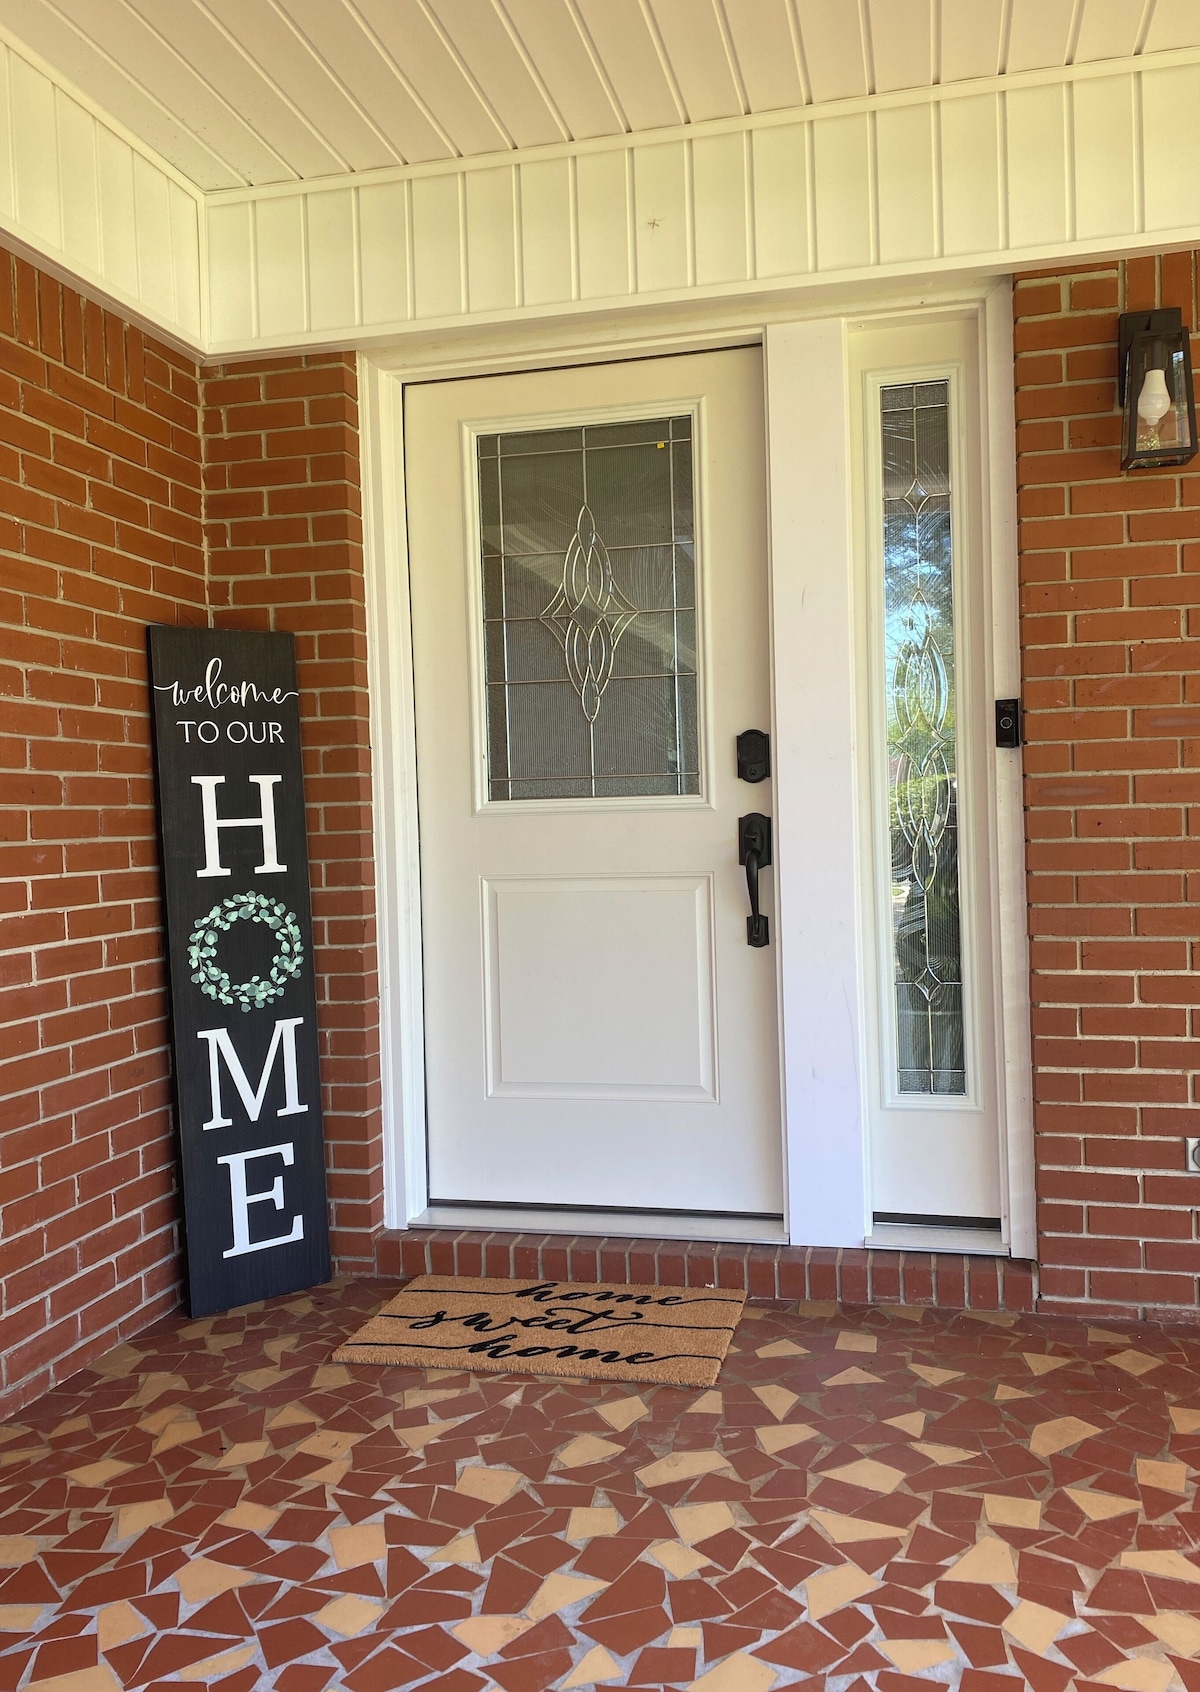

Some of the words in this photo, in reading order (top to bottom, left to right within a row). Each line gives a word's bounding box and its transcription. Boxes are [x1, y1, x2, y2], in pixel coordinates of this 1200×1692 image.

[154, 657, 299, 709] welcome
[176, 720, 219, 744] TO
[226, 720, 285, 744] OUR
[404, 1282, 743, 1306] home
[378, 1307, 735, 1334] sweet
[346, 1334, 723, 1364] home
